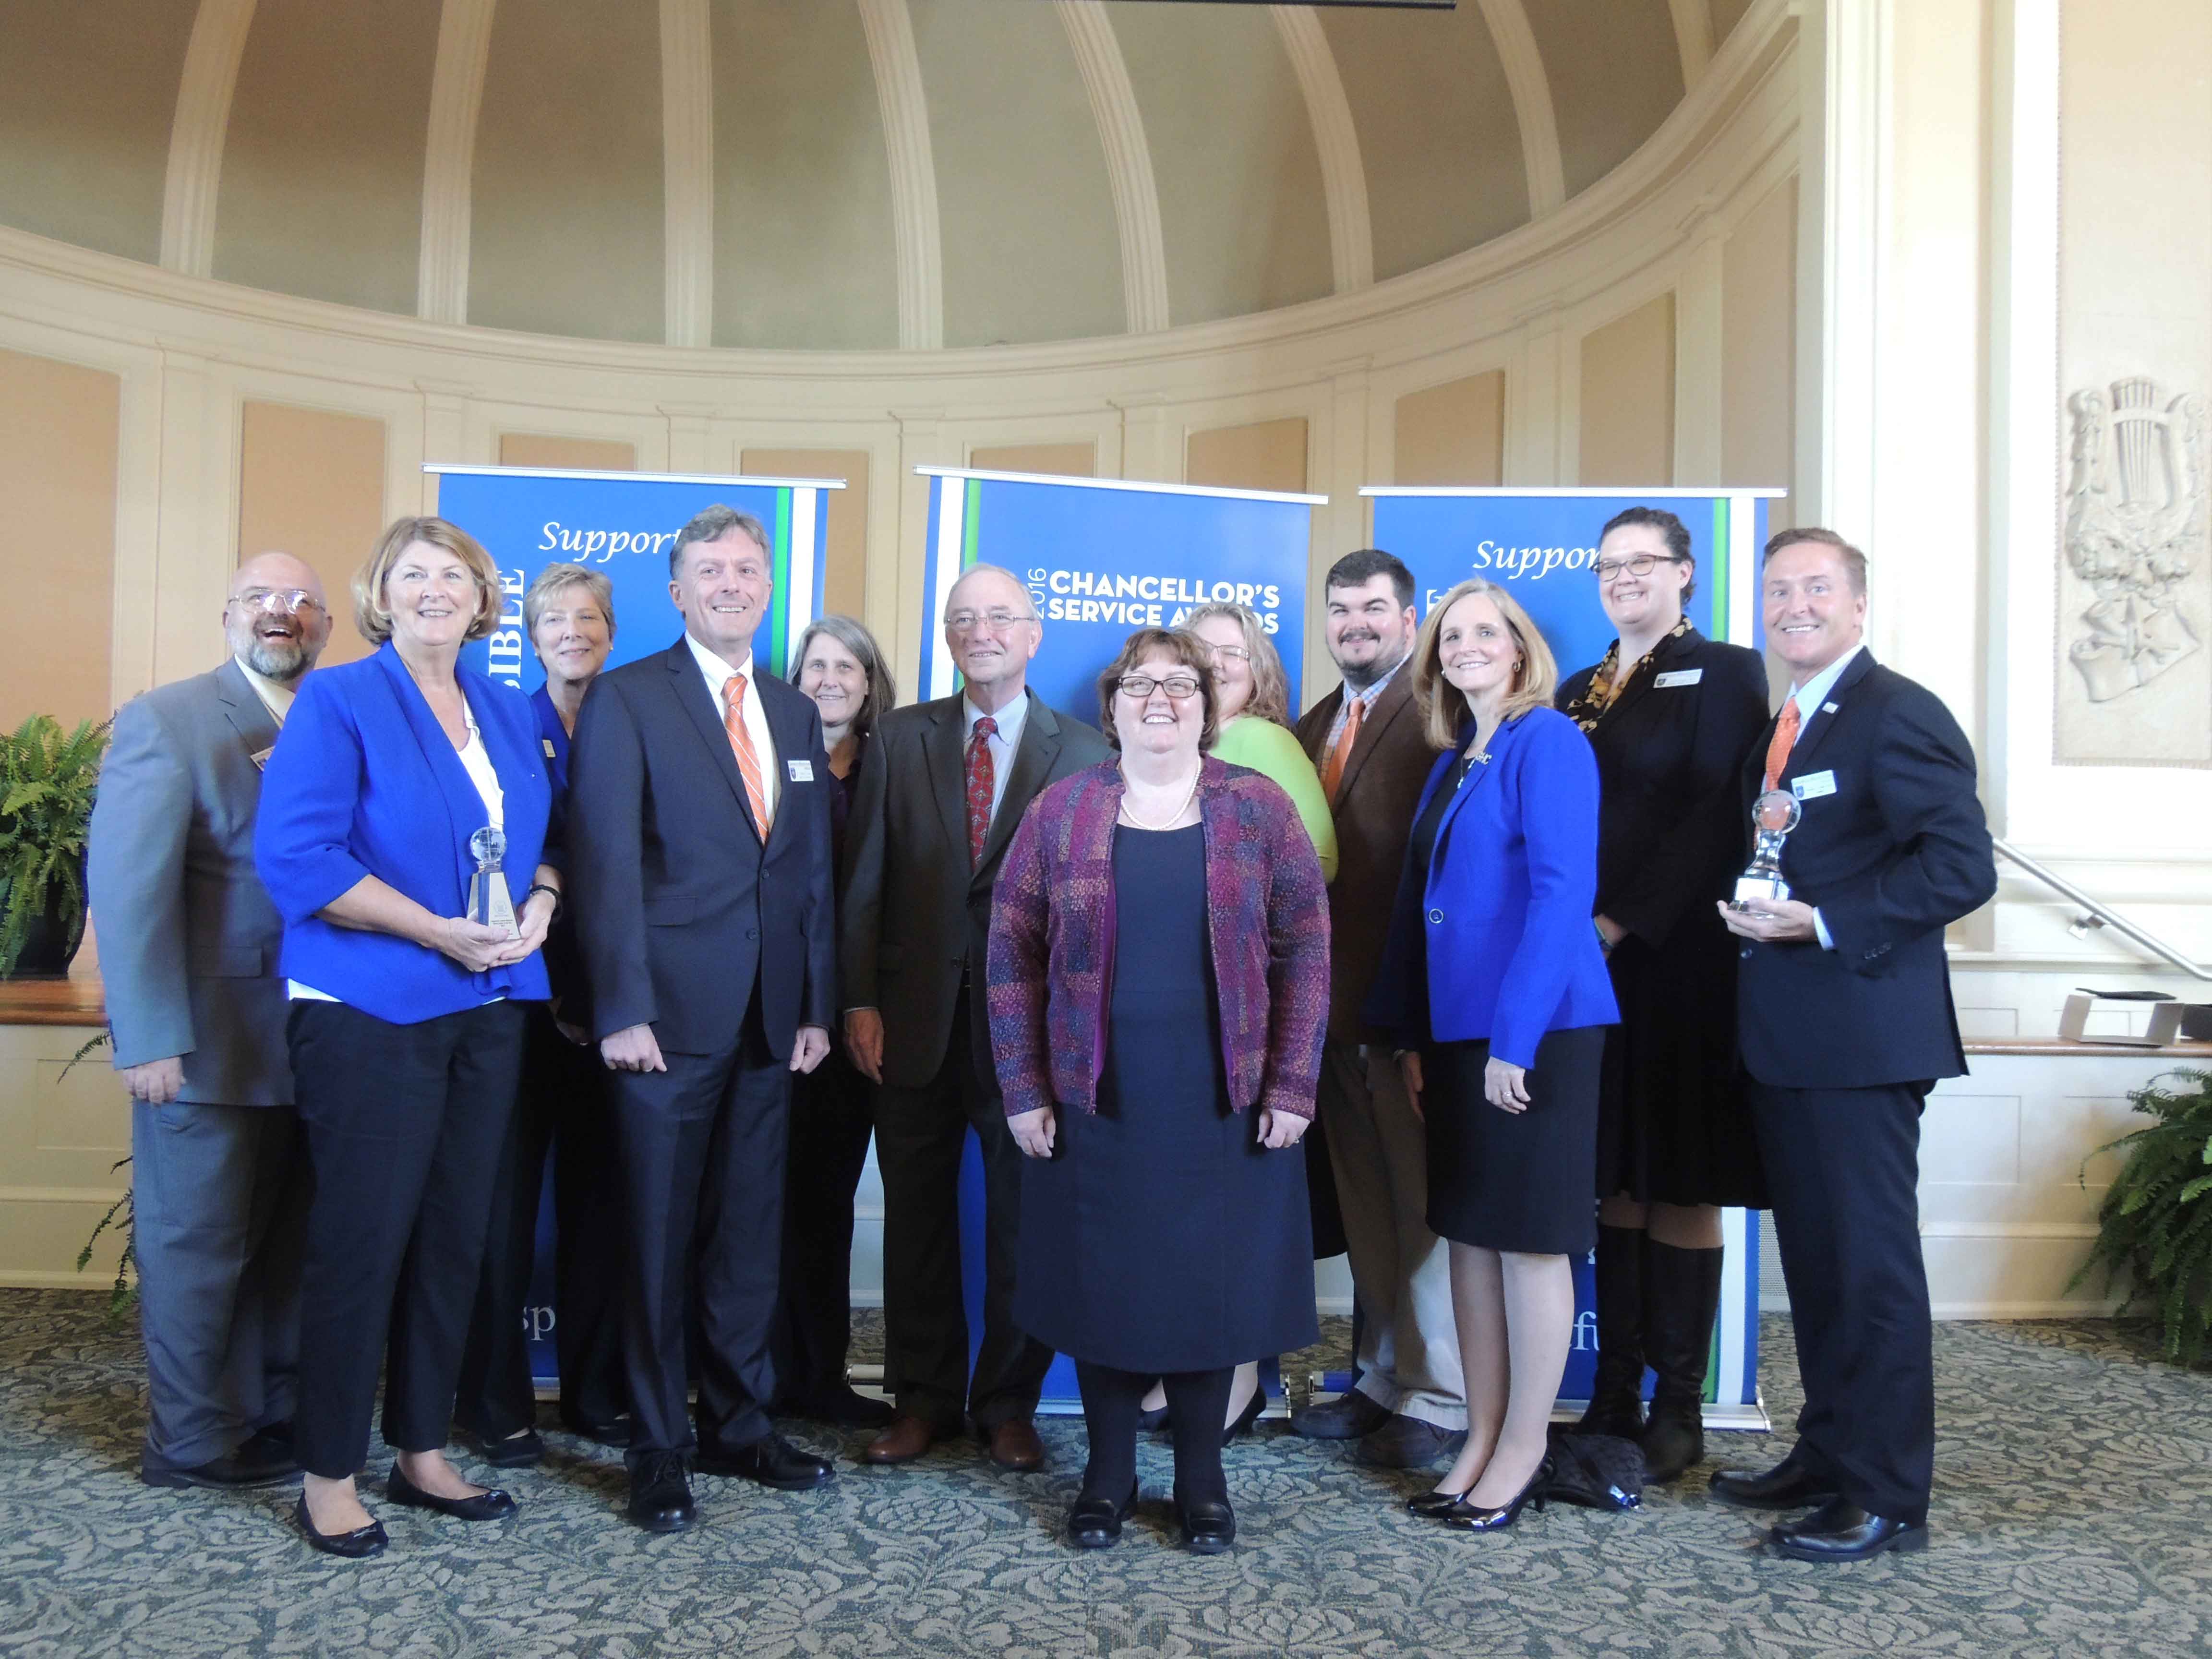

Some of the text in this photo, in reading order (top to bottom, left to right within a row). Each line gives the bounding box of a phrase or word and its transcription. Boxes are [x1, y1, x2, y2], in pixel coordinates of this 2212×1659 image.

[1472, 541, 1599, 579] Suppor
[1049, 570, 1280, 609] CHANCELLOR'S
[489, 569, 525, 690] IBLE
[1047, 598, 1163, 626] SERVICE
